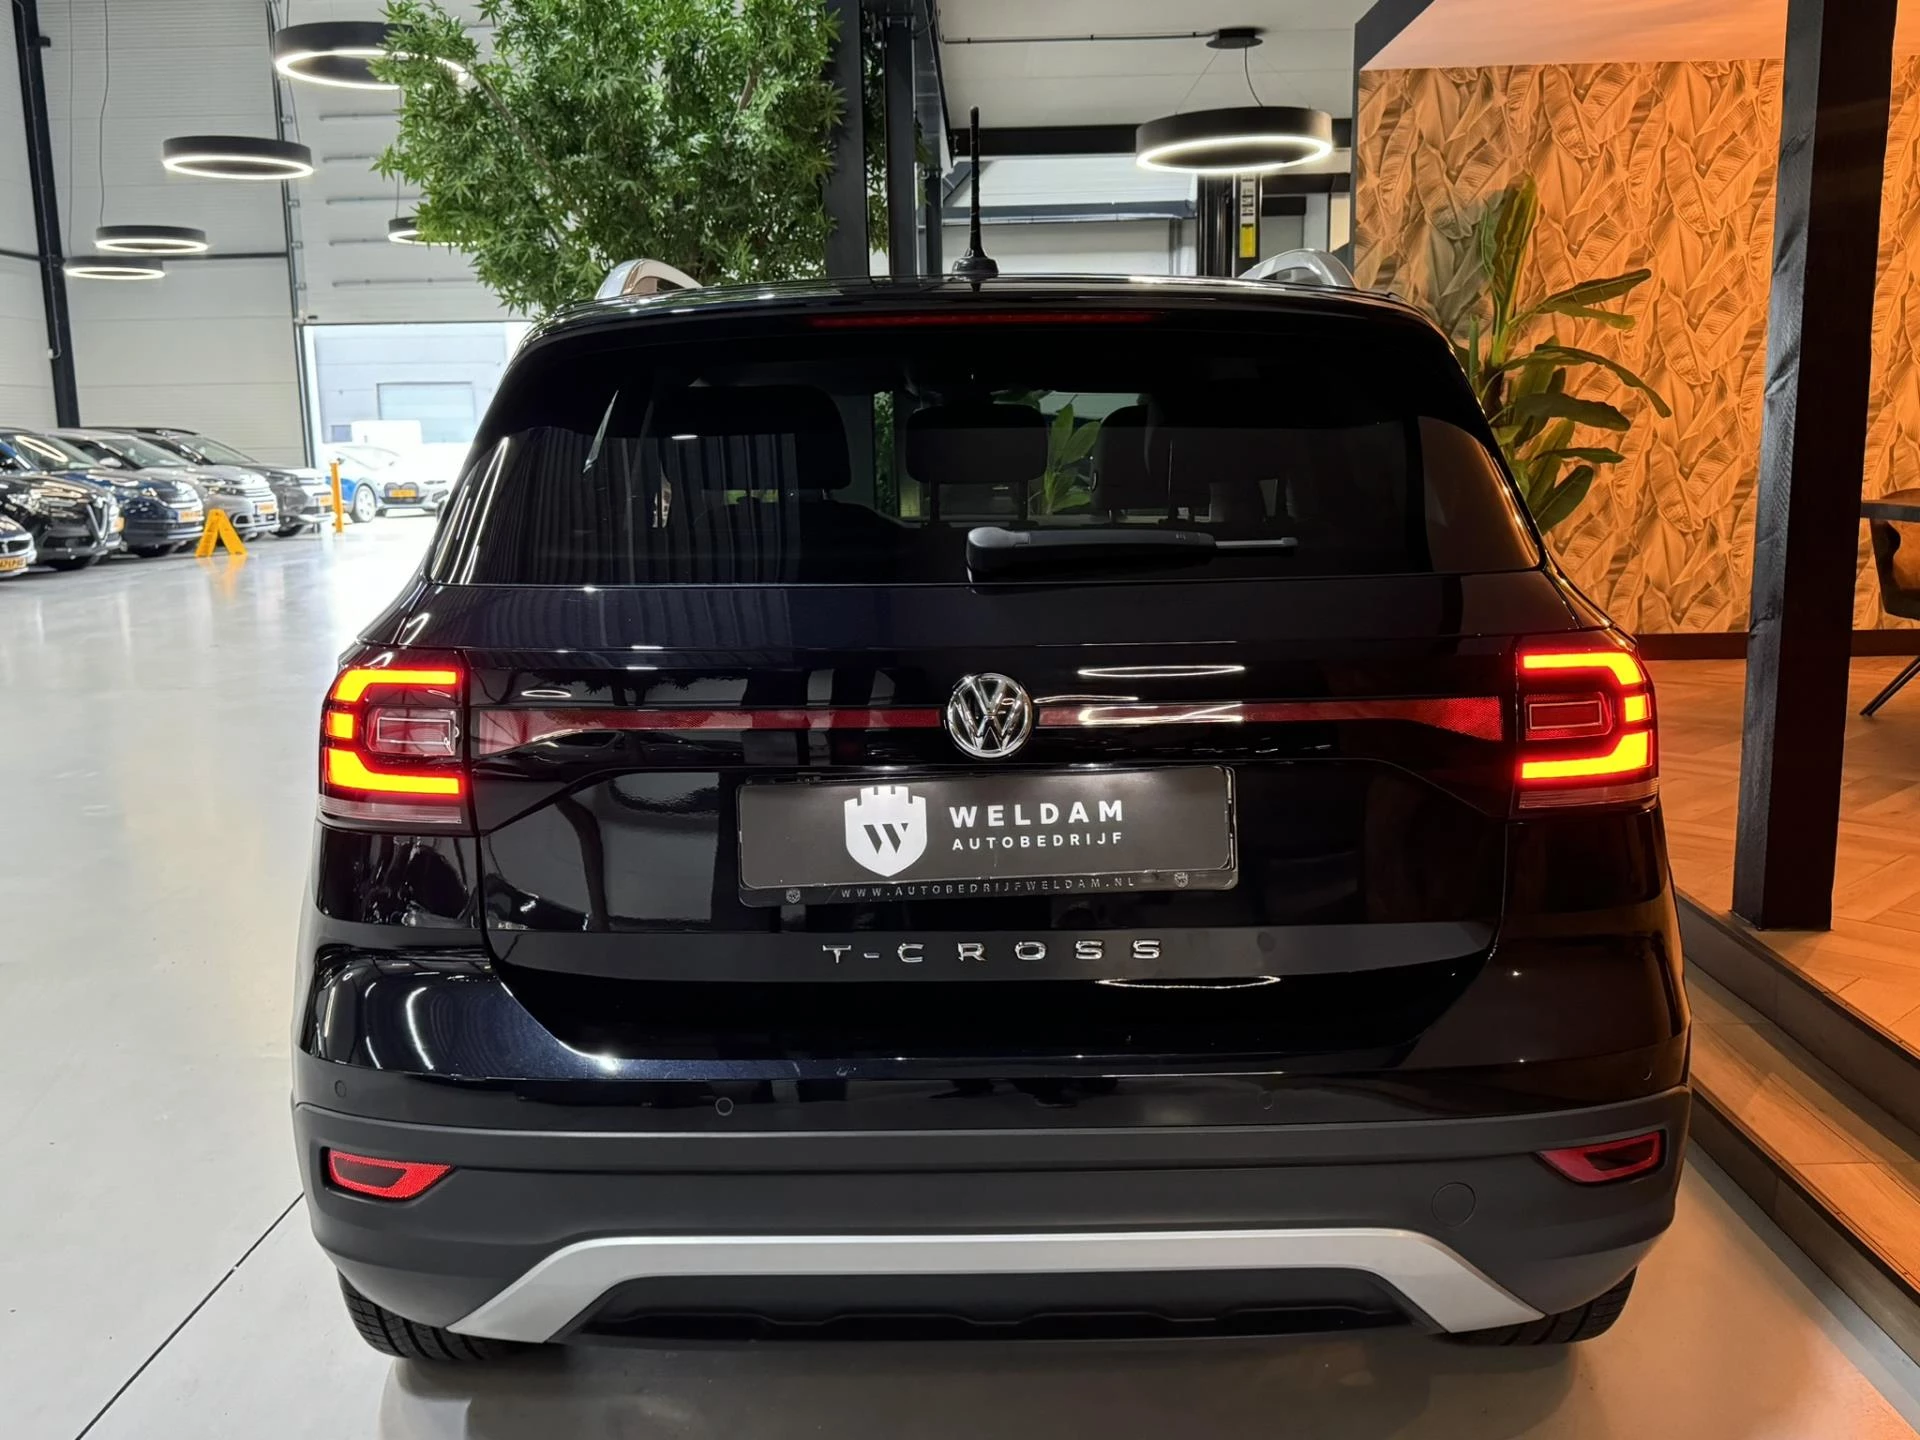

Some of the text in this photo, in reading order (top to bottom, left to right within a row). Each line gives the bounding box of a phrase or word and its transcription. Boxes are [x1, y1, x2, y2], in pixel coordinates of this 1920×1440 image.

[949, 799, 1125, 829] WELDAM
[951, 831, 1124, 852] AUTOBEDRIJF
[841, 877, 1135, 899] WWW.AUTOBEDRIJFWELDAM.NL
[821, 939, 1161, 965] T-CROSS
